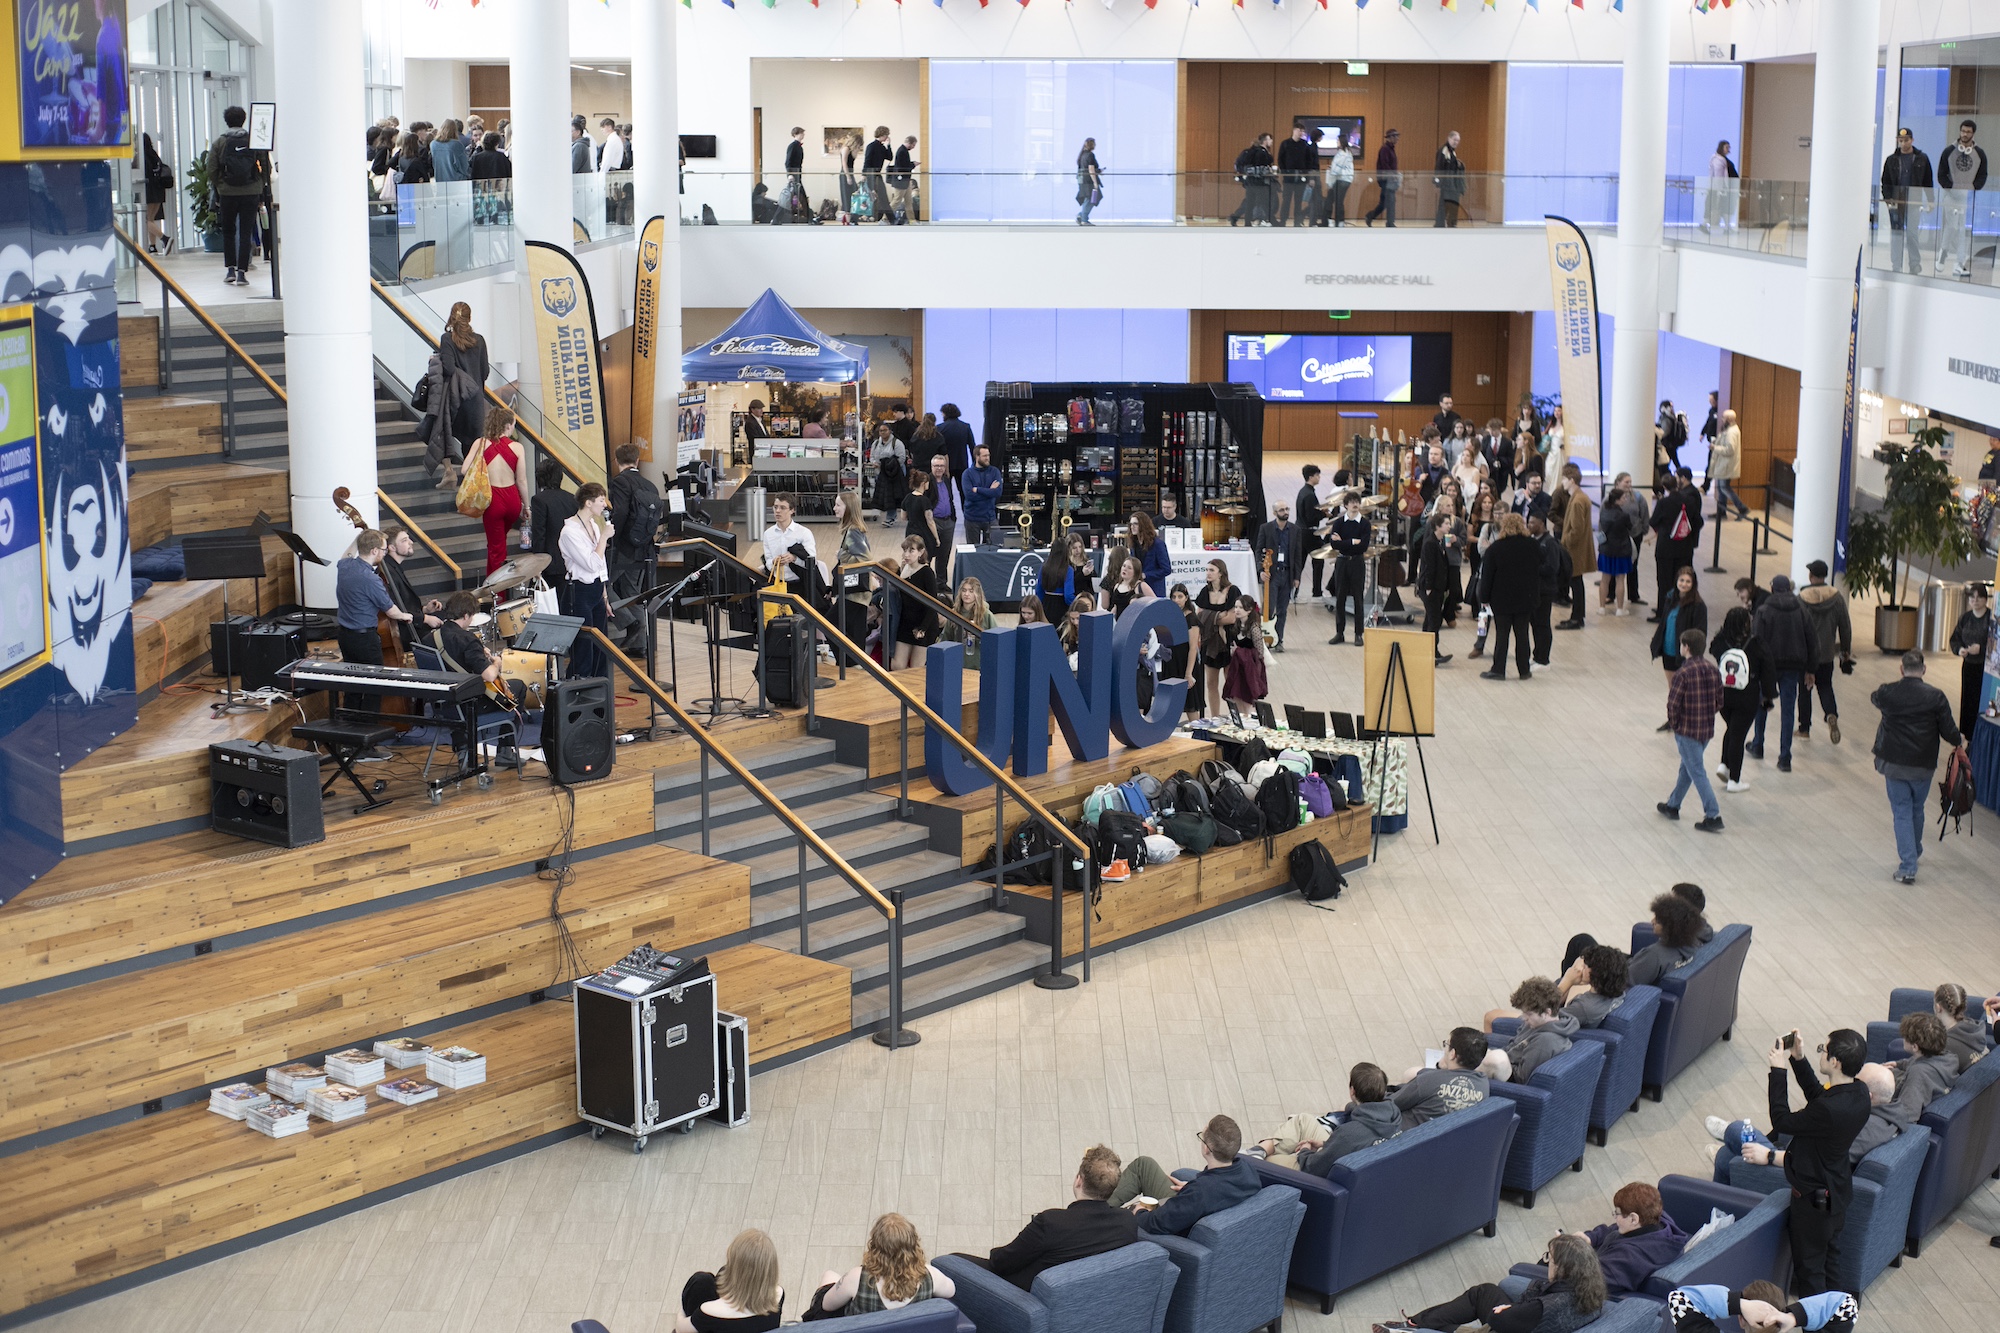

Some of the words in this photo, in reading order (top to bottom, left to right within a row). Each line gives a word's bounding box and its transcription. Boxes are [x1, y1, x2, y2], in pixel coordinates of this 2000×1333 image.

[34, 43, 72, 94] Camp
[38, 106, 53, 125] July
[1304, 274, 1400, 285] PERFORMANCE
[1402, 275, 1434, 286] HALL
[637, 279, 646, 354] COLORADO
[643, 278, 652, 359] NORTHERN
[1021, 566, 1036, 576] St.
[925, 597, 1189, 796] UNC
[1437, 1084, 1462, 1099] JAZZ
[1461, 1087, 1484, 1102] BAND
